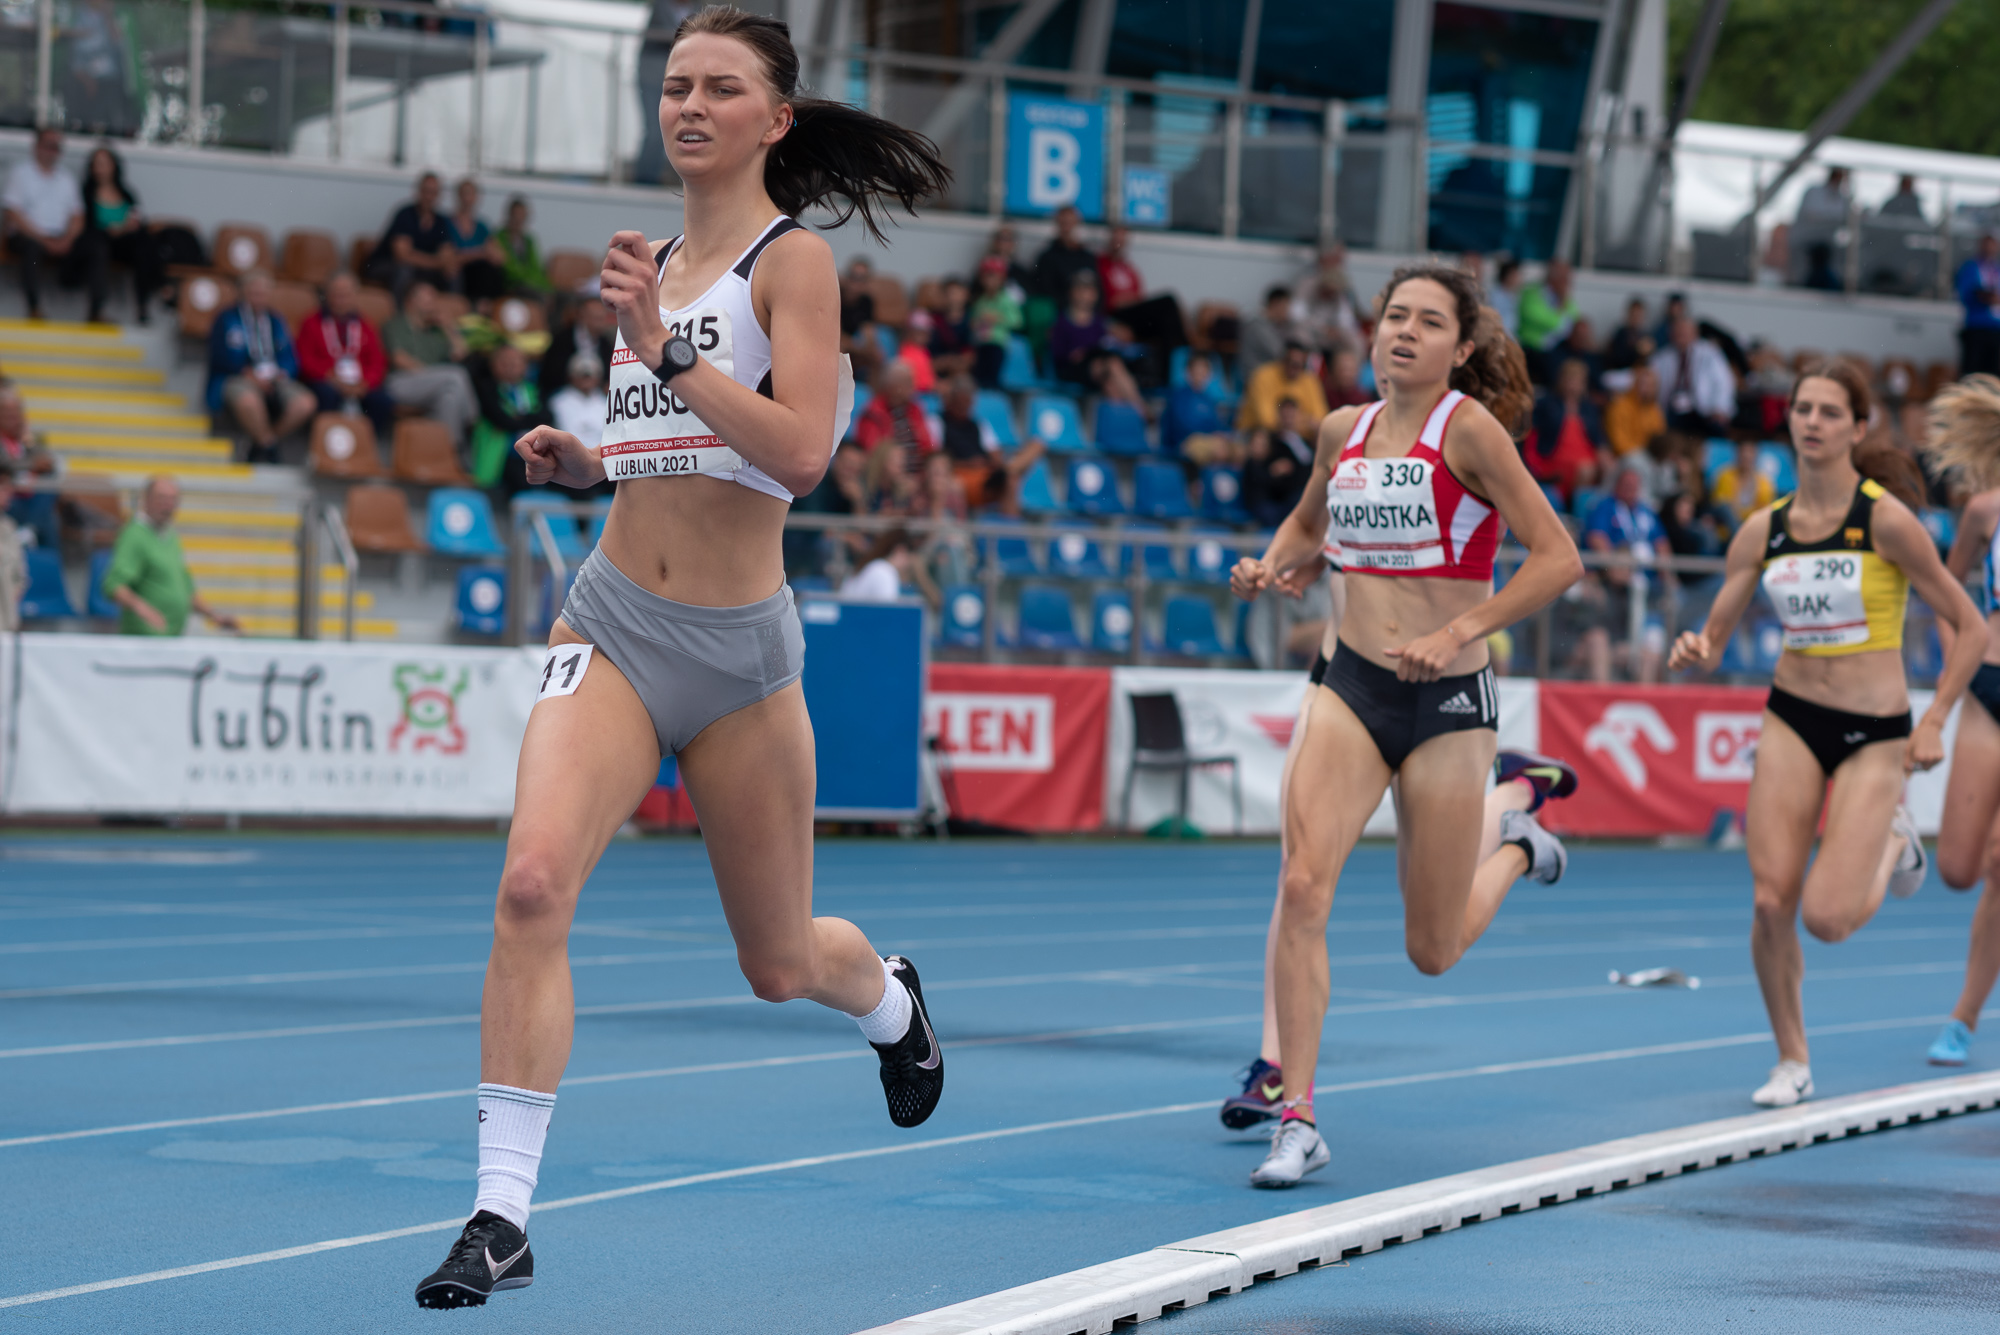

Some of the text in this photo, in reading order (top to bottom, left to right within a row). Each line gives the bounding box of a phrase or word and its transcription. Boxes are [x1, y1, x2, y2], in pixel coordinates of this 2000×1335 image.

[1029, 129, 1081, 206] B
[623, 440, 674, 452] MISTRZOSTWA
[674, 437, 709, 447] POLSKI
[615, 455, 698, 476] LUBLIN 2021
[1382, 463, 1424, 486] 330
[1331, 504, 1433, 529] KAPUSTKA
[1356, 554, 1415, 566] LUBLIN 2021
[1814, 558, 1855, 580] 290
[1788, 593, 1832, 618] BĄK
[540, 653, 582, 693] 11
